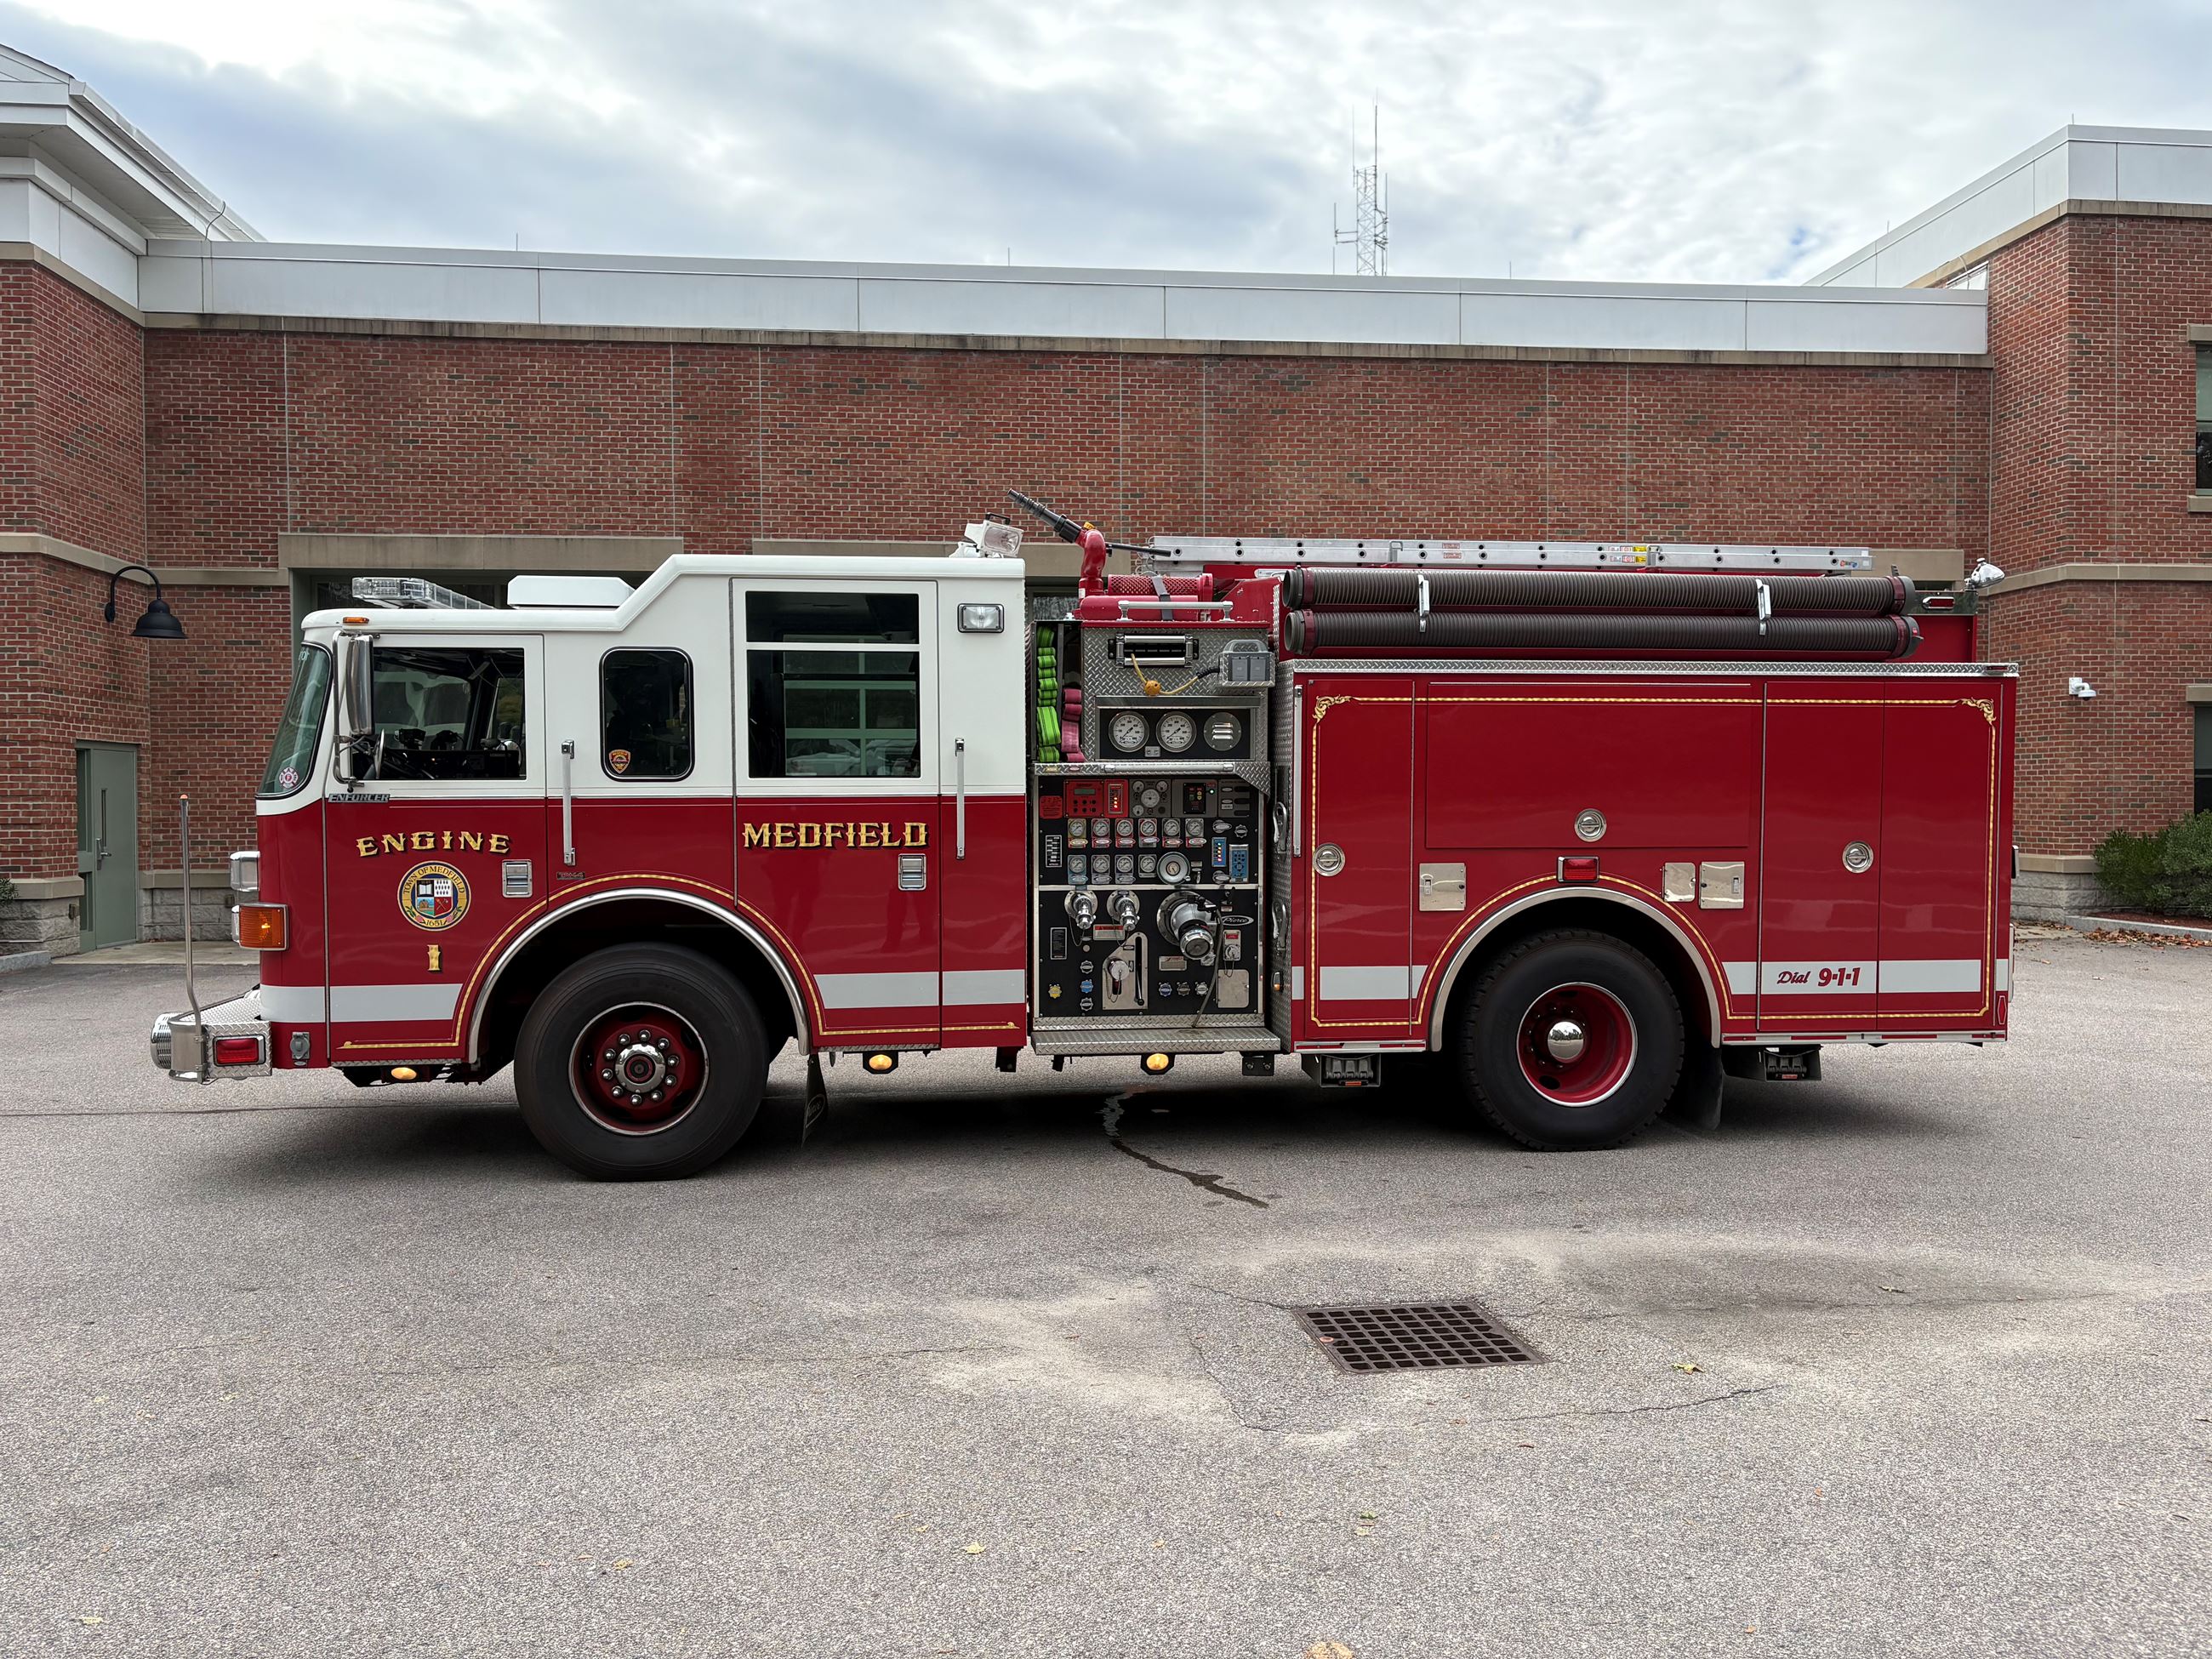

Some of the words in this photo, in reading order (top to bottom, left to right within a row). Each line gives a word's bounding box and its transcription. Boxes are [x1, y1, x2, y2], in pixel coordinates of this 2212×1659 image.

[328, 794, 390, 802] ENFORCER
[356, 830, 511, 857] ENGINE
[742, 822, 928, 847] MEDFIELD
[403, 873, 419, 893] TOWN
[417, 866, 429, 876] OF
[430, 865, 465, 893] MEDFIELD
[427, 944, 442, 971] 1
[1776, 971, 1811, 984] Dial
